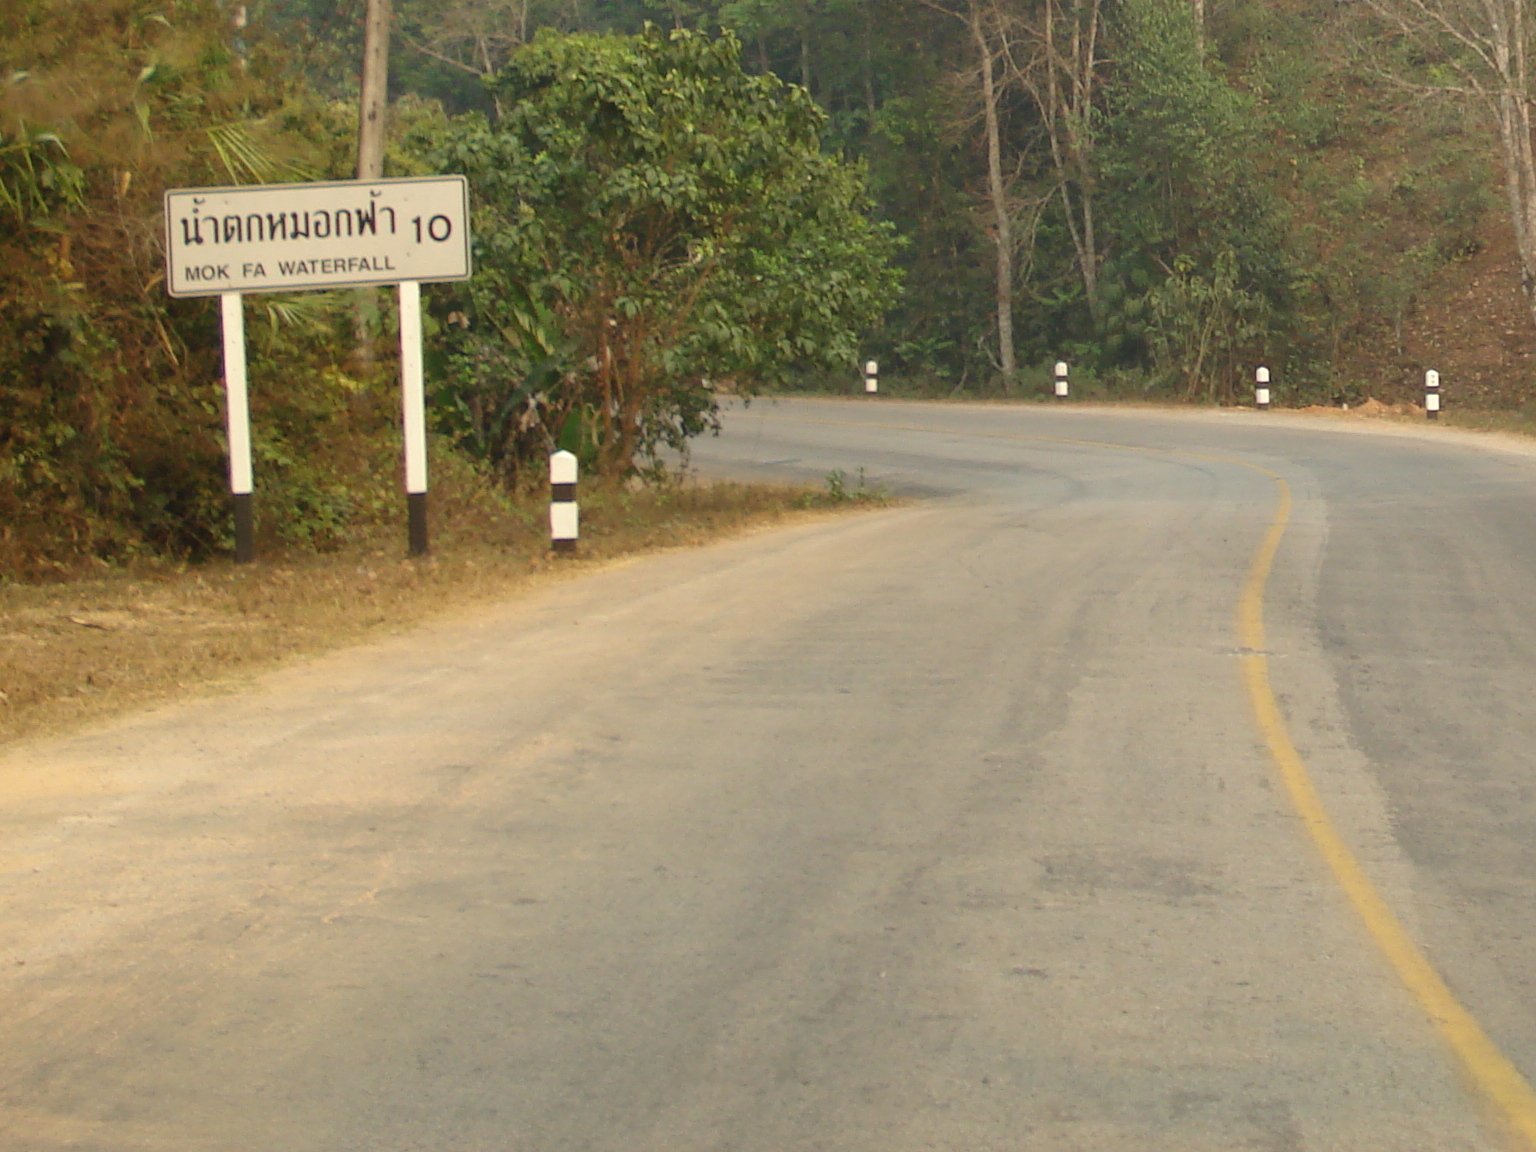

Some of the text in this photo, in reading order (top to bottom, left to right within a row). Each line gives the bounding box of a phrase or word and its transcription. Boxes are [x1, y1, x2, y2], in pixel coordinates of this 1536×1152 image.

[181, 190, 452, 246] น้ำตกหมอกฟ้า 10
[184, 256, 395, 282] MOK FA WATERFALL
